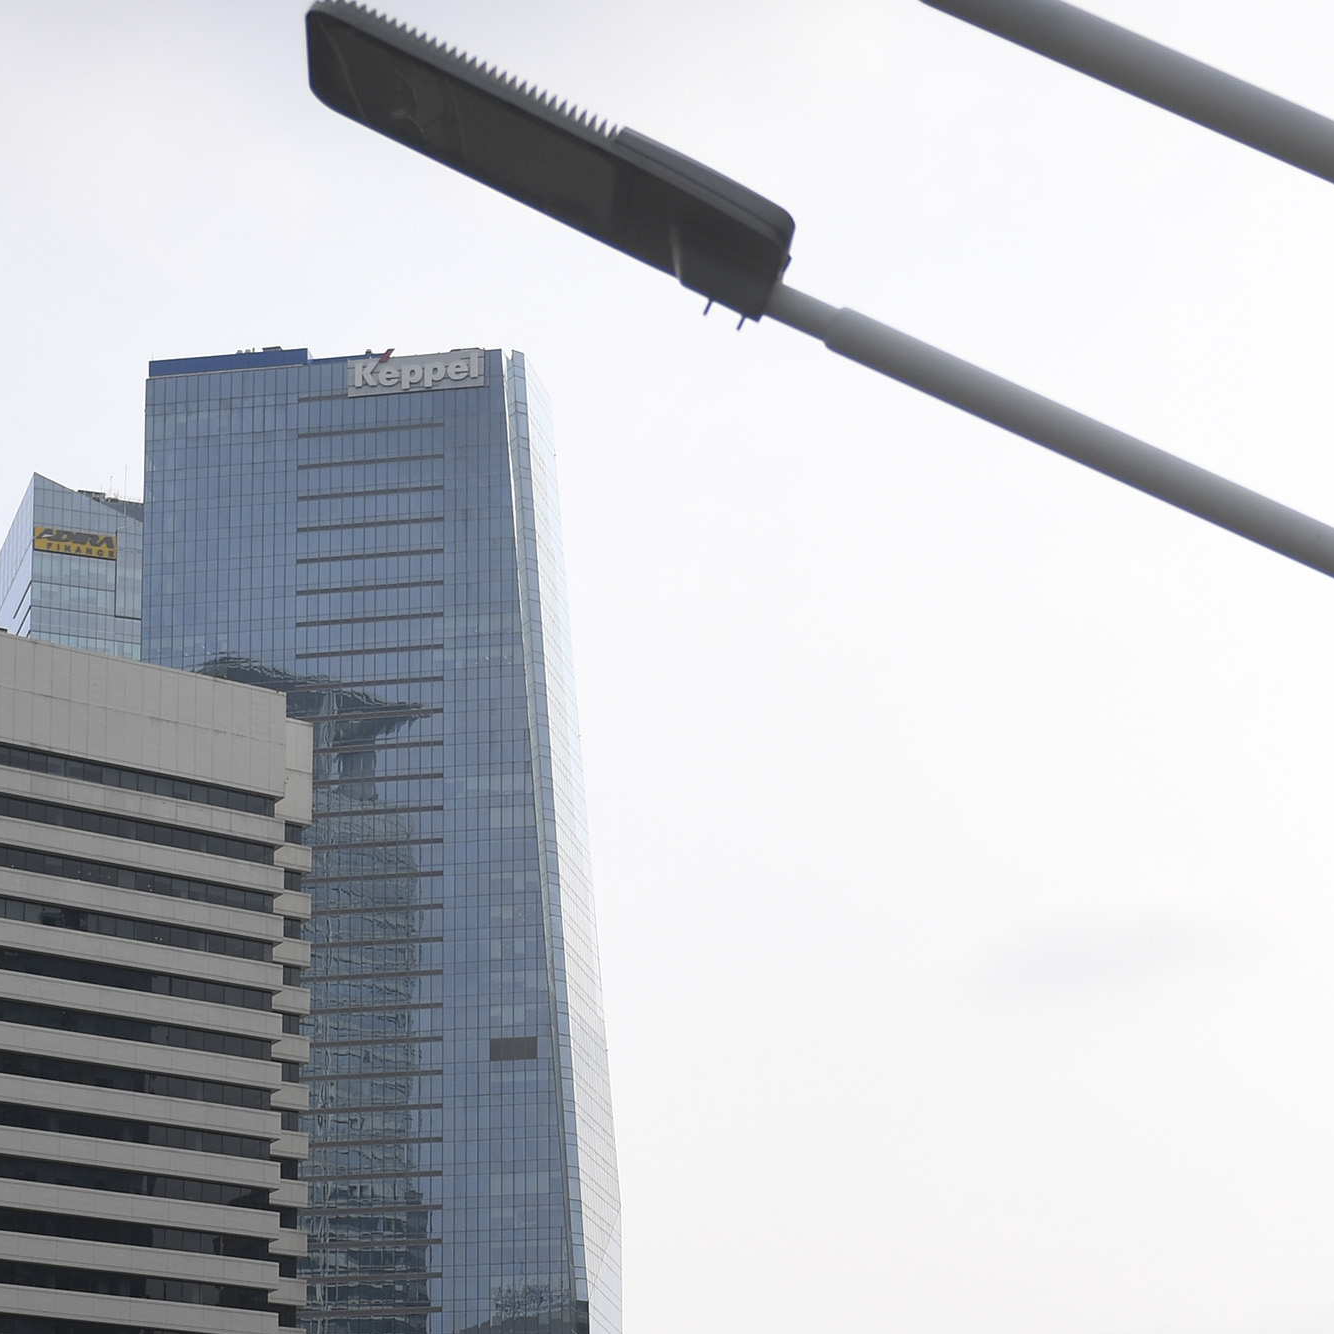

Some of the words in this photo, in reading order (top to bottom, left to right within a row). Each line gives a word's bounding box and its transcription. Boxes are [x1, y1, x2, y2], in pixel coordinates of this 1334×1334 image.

[354, 348, 479, 390] Keppel
[36, 528, 115, 549] ADIRA
[47, 542, 115, 557] FINANCE
